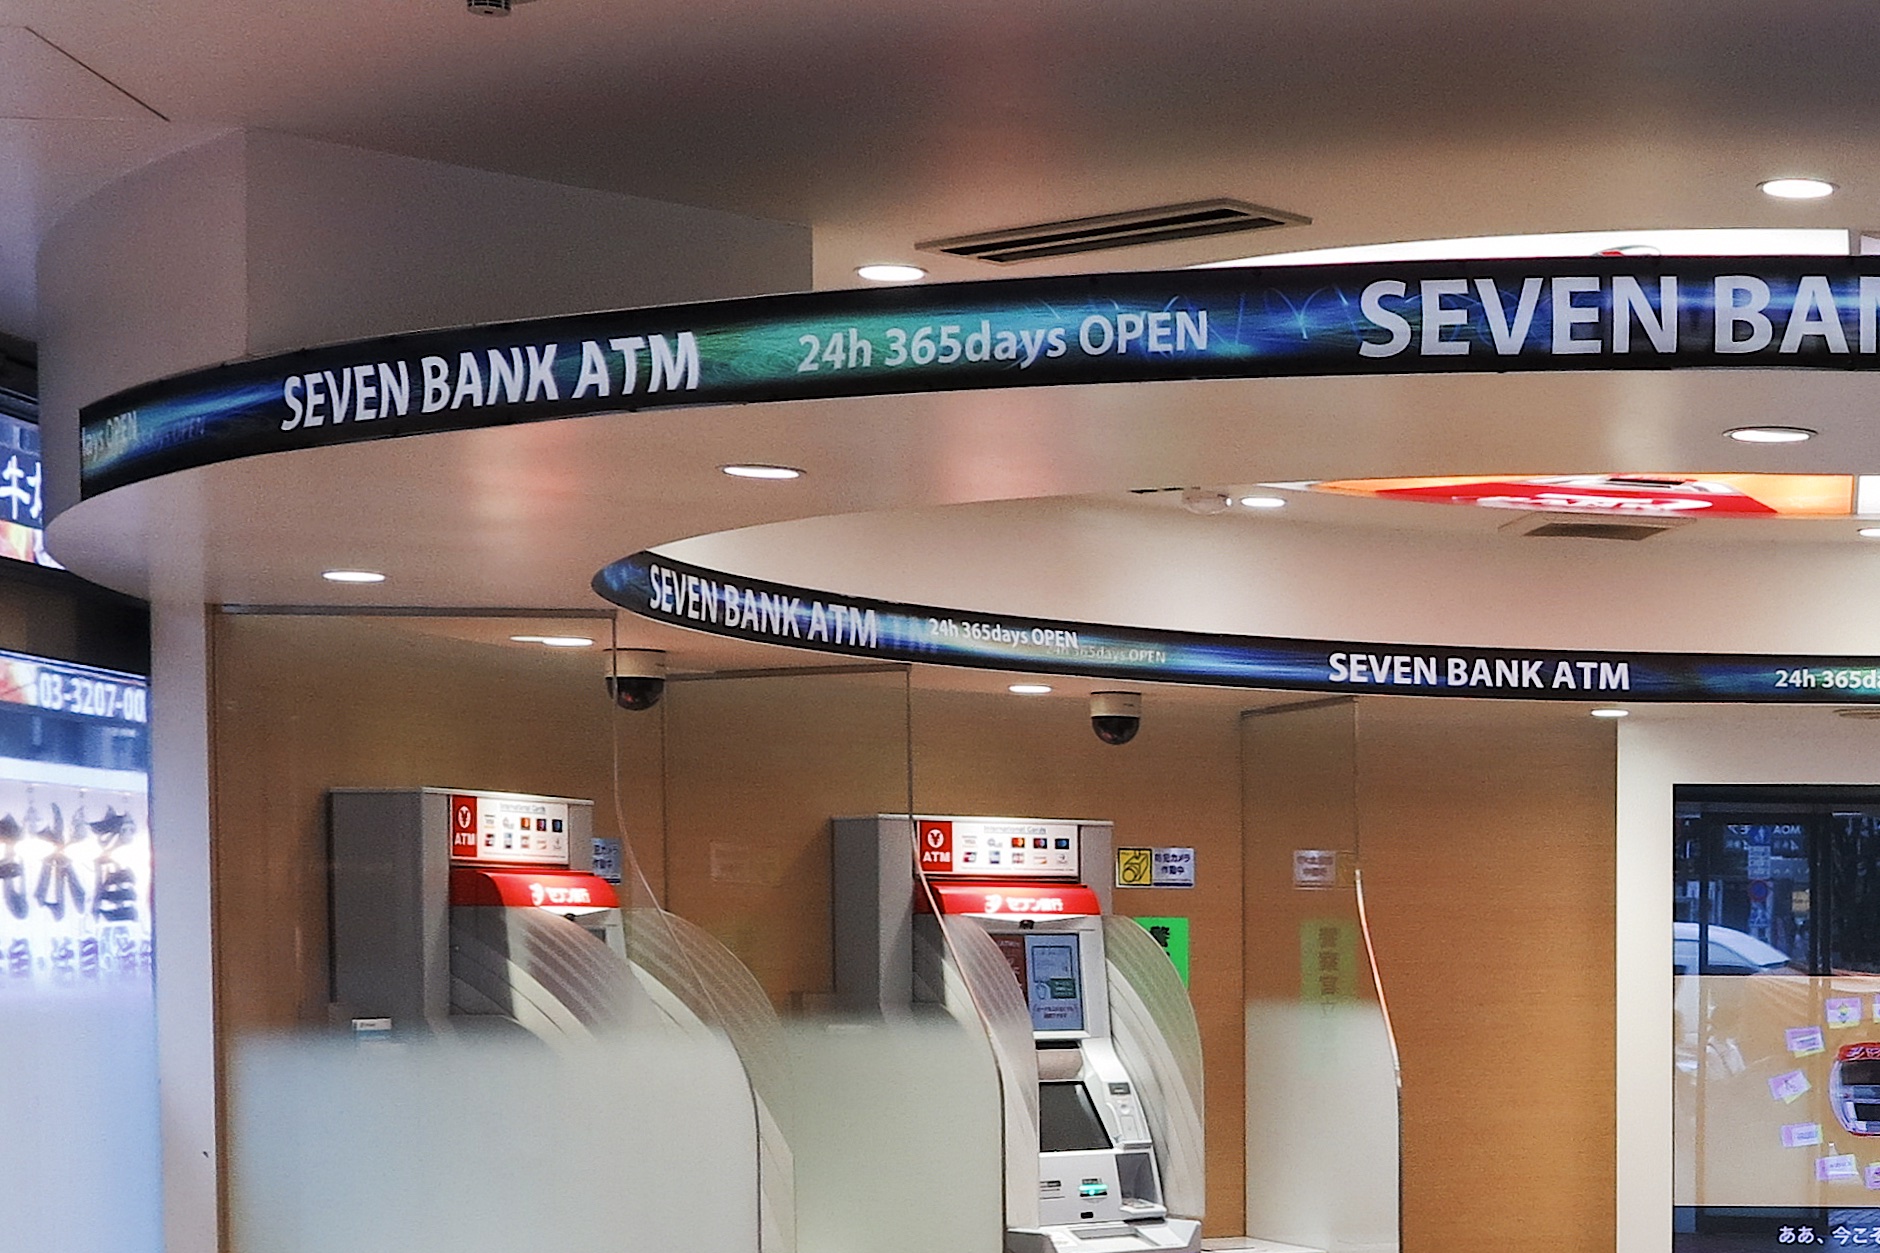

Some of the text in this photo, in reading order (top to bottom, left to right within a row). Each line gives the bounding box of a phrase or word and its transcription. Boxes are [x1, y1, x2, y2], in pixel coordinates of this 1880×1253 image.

[1358, 276, 1678, 358] SEVEN
[797, 310, 1209, 373] 24h 365days OPEN
[280, 331, 698, 430] SEVEN BANK ATM
[649, 563, 878, 650] SEVEN BANK ATM
[929, 618, 1079, 649] 24h 365days OPEN
[1328, 652, 1630, 692] SEVEN BANK ATM
[1774, 668, 1817, 689] 24h
[454, 832, 476, 846] ATM
[922, 851, 951, 863] ATM
